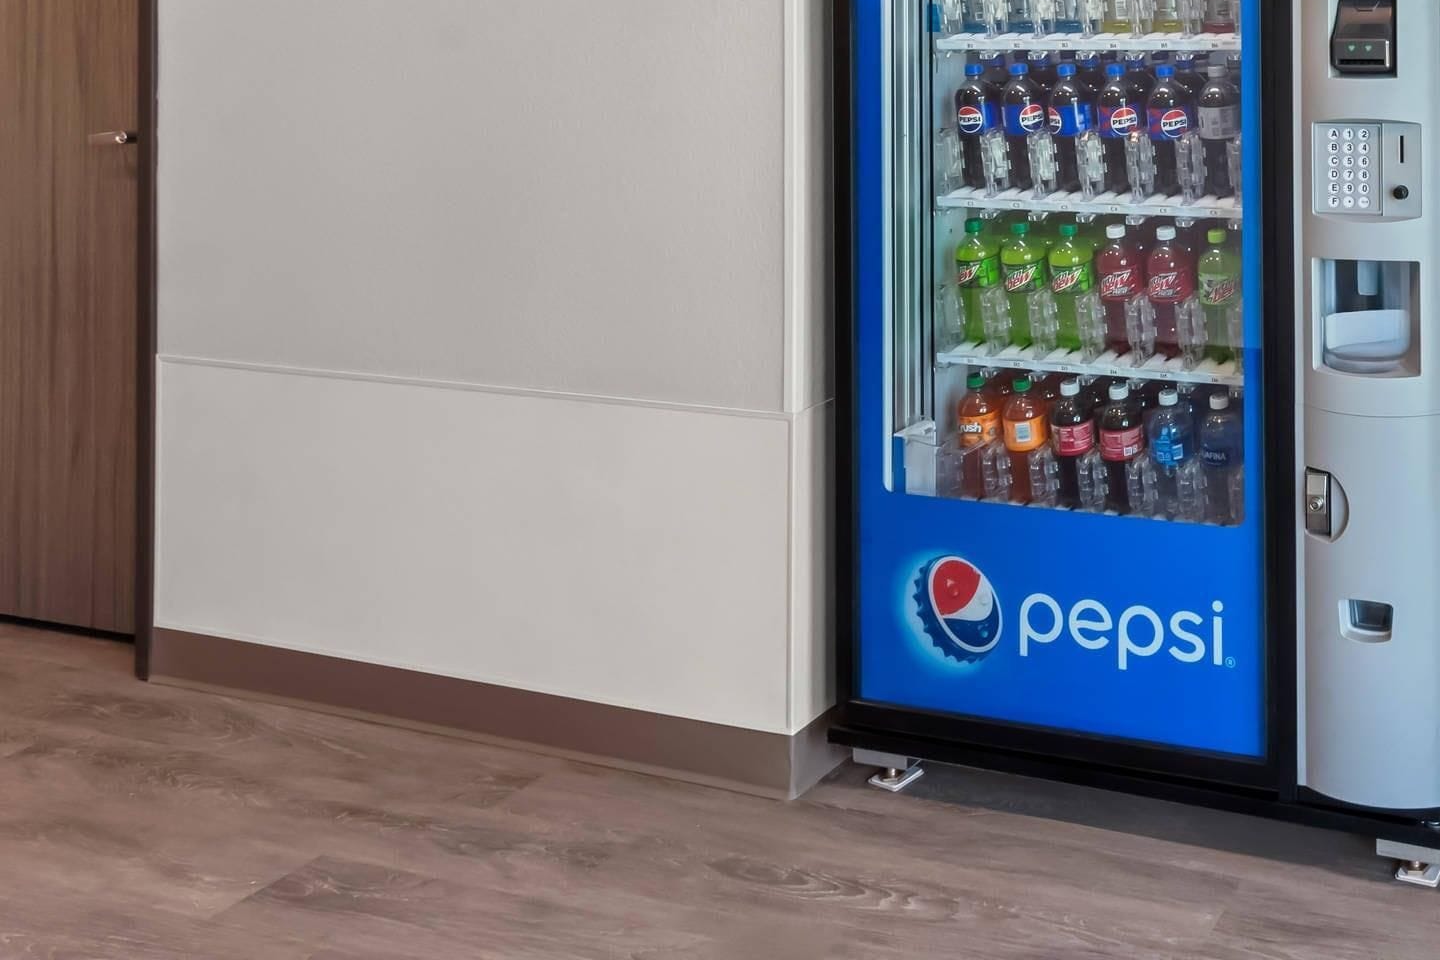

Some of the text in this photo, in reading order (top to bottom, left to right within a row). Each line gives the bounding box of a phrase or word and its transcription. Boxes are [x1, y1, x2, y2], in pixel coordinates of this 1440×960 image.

[1112, 116, 1137, 126] PEPSI
[1162, 120, 1186, 128] PEPSI
[1361, 130, 1367, 138] 2
[960, 422, 982, 432] rush
[1020, 593, 1223, 670] pepsi
